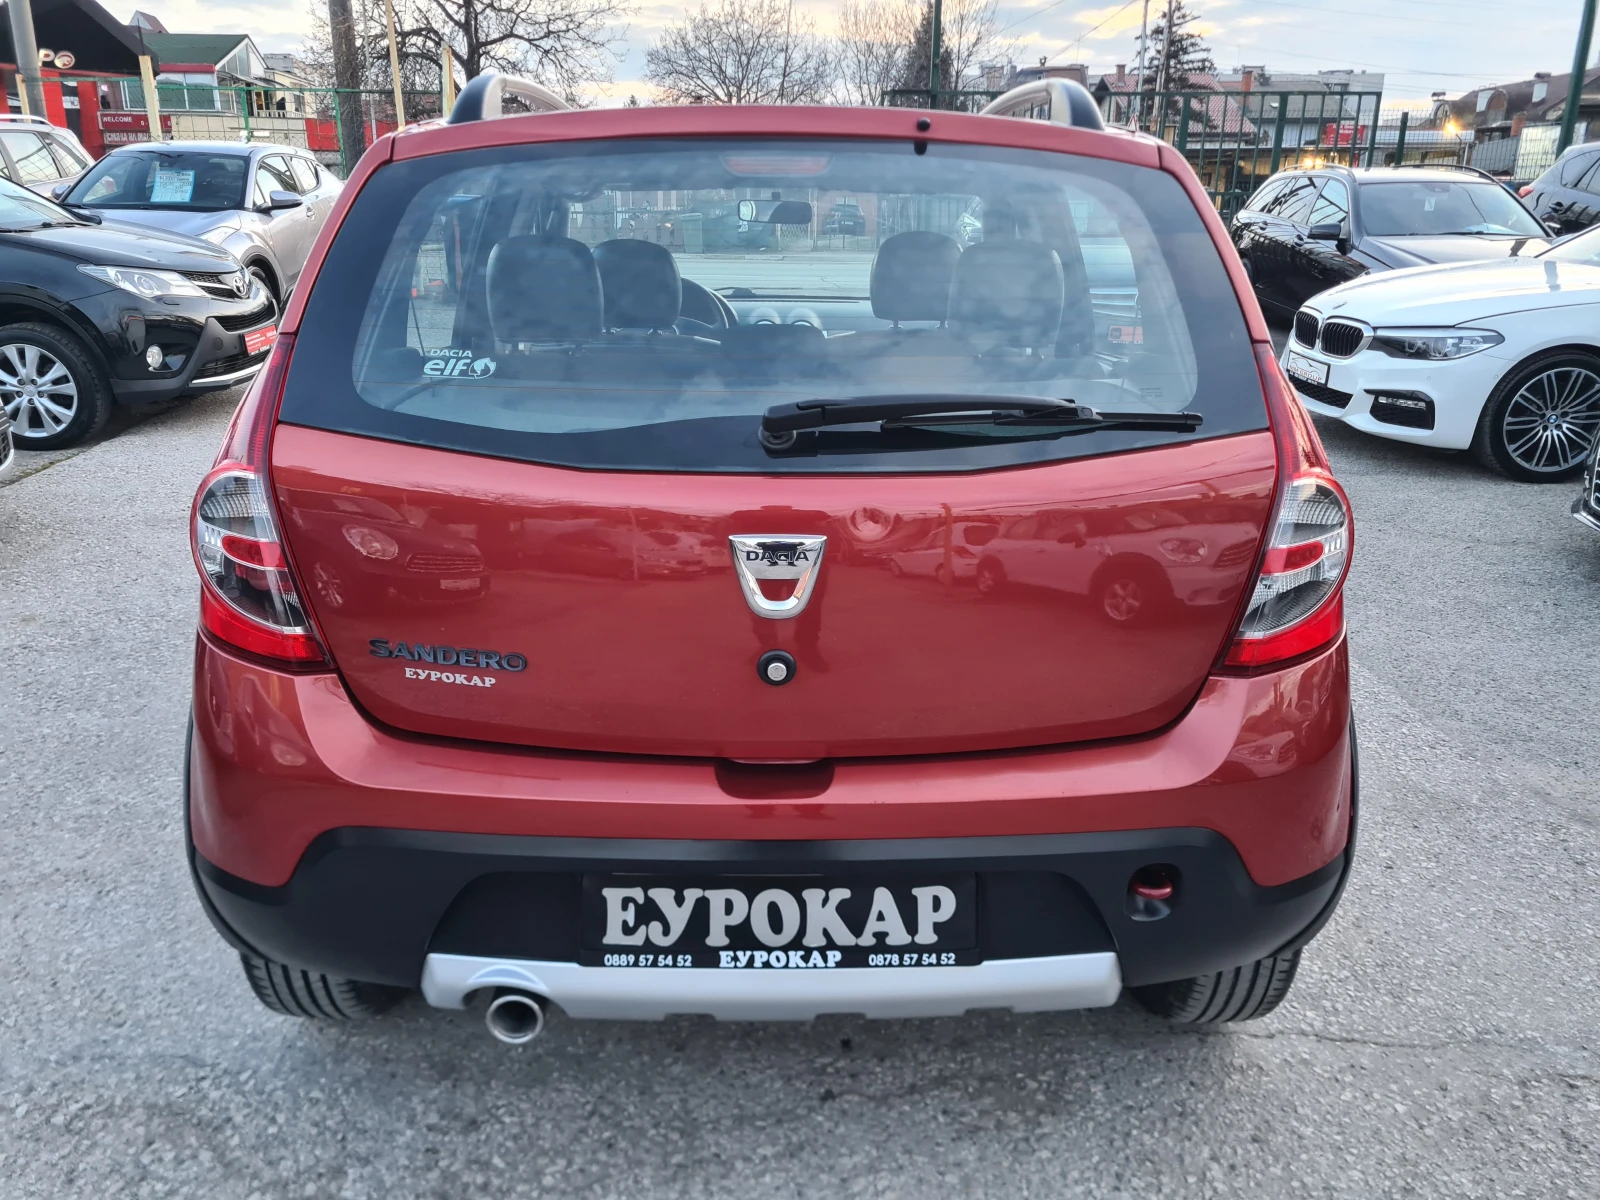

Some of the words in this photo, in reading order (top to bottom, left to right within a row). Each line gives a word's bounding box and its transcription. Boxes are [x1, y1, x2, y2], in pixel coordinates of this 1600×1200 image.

[429, 348, 473, 357] DACIA
[423, 358, 471, 376] elf
[746, 550, 810, 562] DACIA
[369, 637, 528, 672] SANDERO
[404, 667, 496, 688] ЕУРОКАР
[601, 885, 957, 947] ЕУРОКАР
[603, 954, 635, 967] 0889
[638, 954, 654, 967] 57
[657, 954, 673, 967] 54
[676, 954, 692, 967] 52
[718, 950, 842, 968] ЕУРОКАР
[868, 954, 900, 966] 0878
[902, 954, 918, 966] 57
[921, 953, 937, 965] 54
[940, 952, 956, 965] 52
